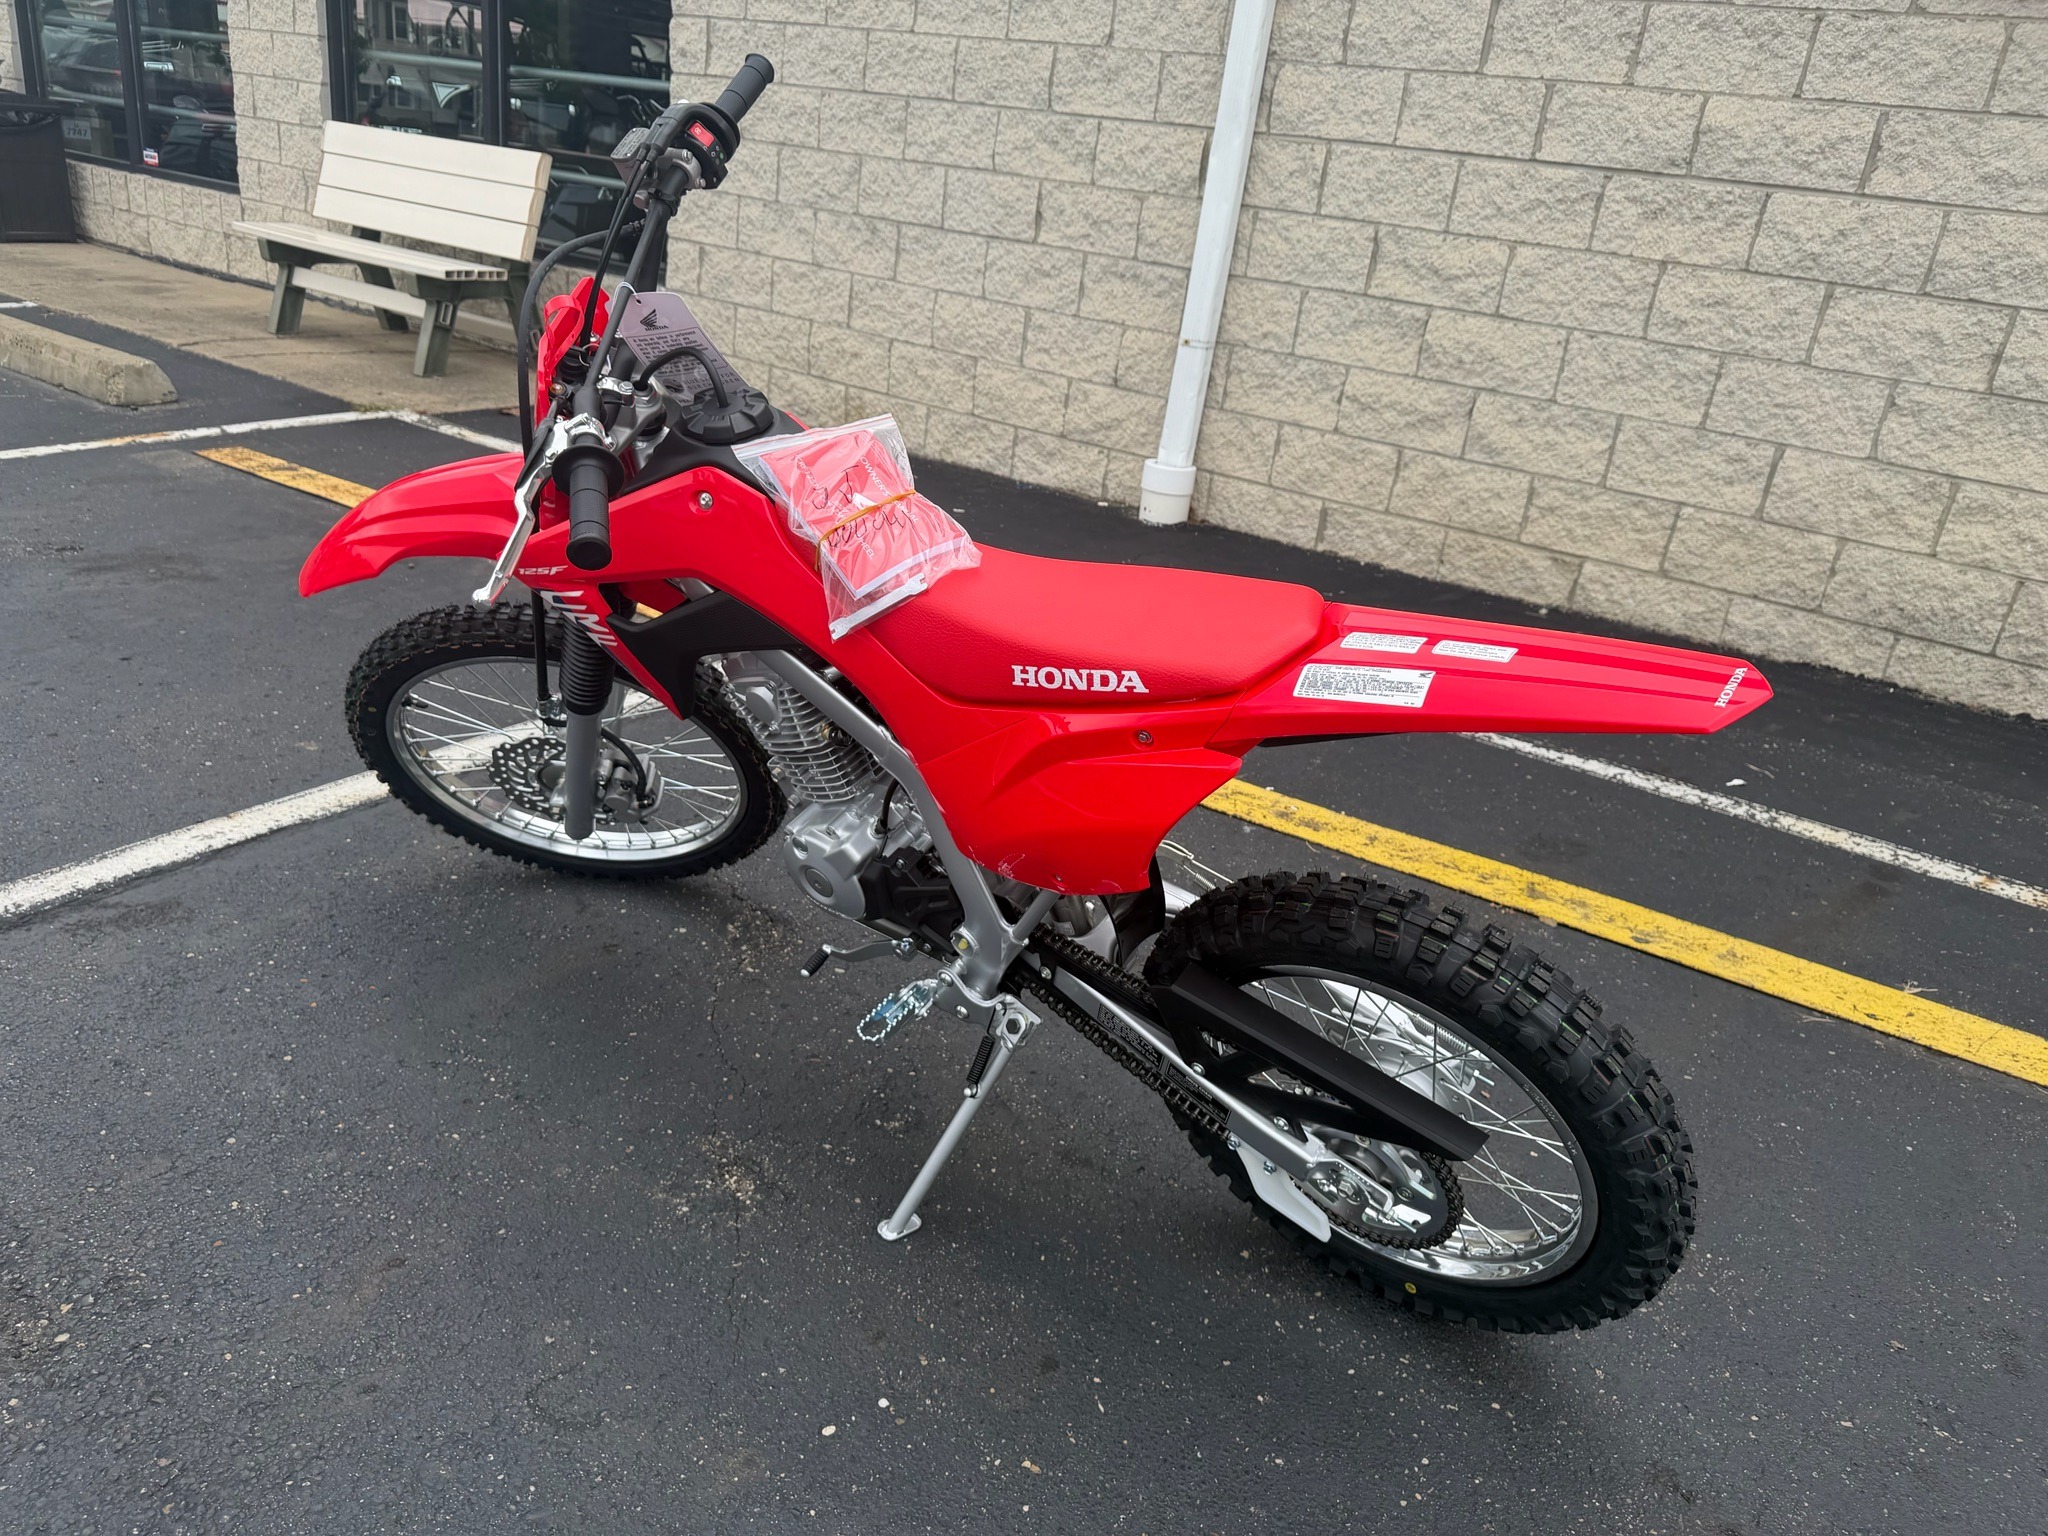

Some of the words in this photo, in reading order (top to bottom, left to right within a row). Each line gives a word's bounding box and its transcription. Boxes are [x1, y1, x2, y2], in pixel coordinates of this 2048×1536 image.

[518, 565, 568, 575] 125F
[1011, 665, 1150, 694] HONDA
[1714, 667, 1748, 708] HONDA
